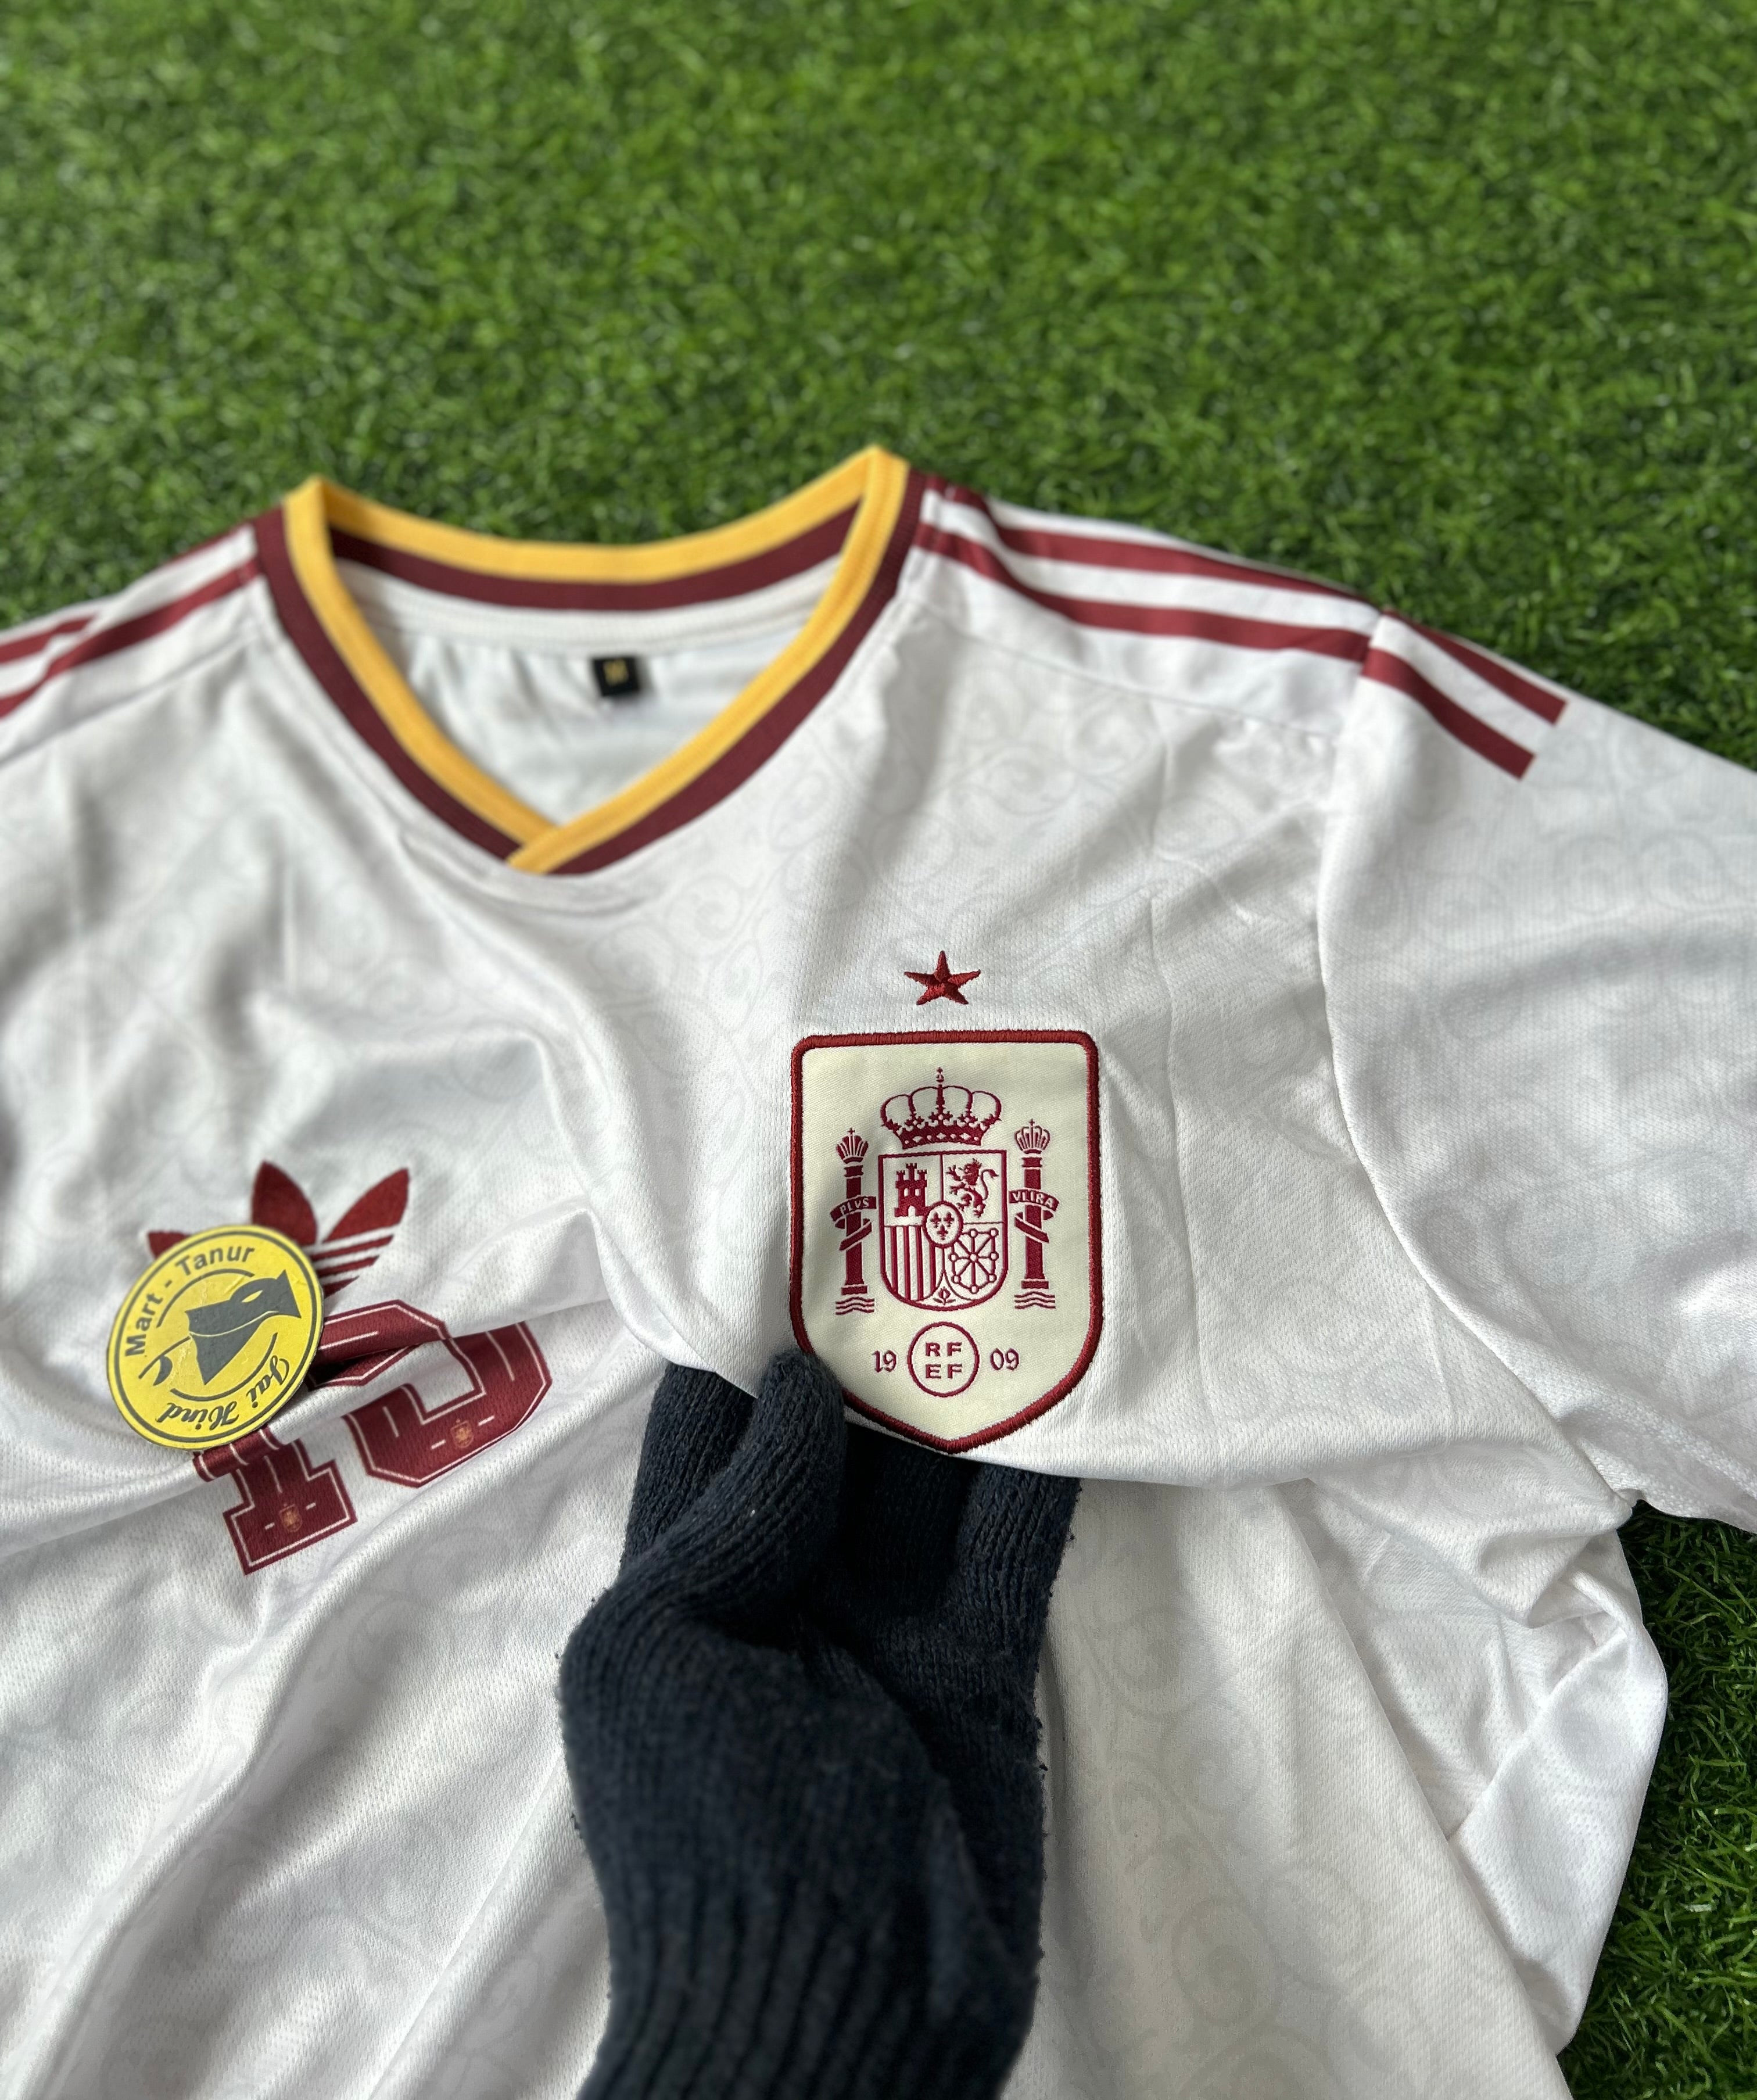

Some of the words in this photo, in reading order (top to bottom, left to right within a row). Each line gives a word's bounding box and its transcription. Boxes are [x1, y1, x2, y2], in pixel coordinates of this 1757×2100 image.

[124, 1295, 163, 1357] Mart
[174, 1245, 256, 1277] Tanur
[872, 1349, 897, 1372] 19
[925, 1342, 963, 1357] RF
[989, 1348, 1020, 1371] 09
[245, 1354, 290, 1409] Jai
[925, 1363, 963, 1379] EF
[155, 1401, 240, 1431] Hind
